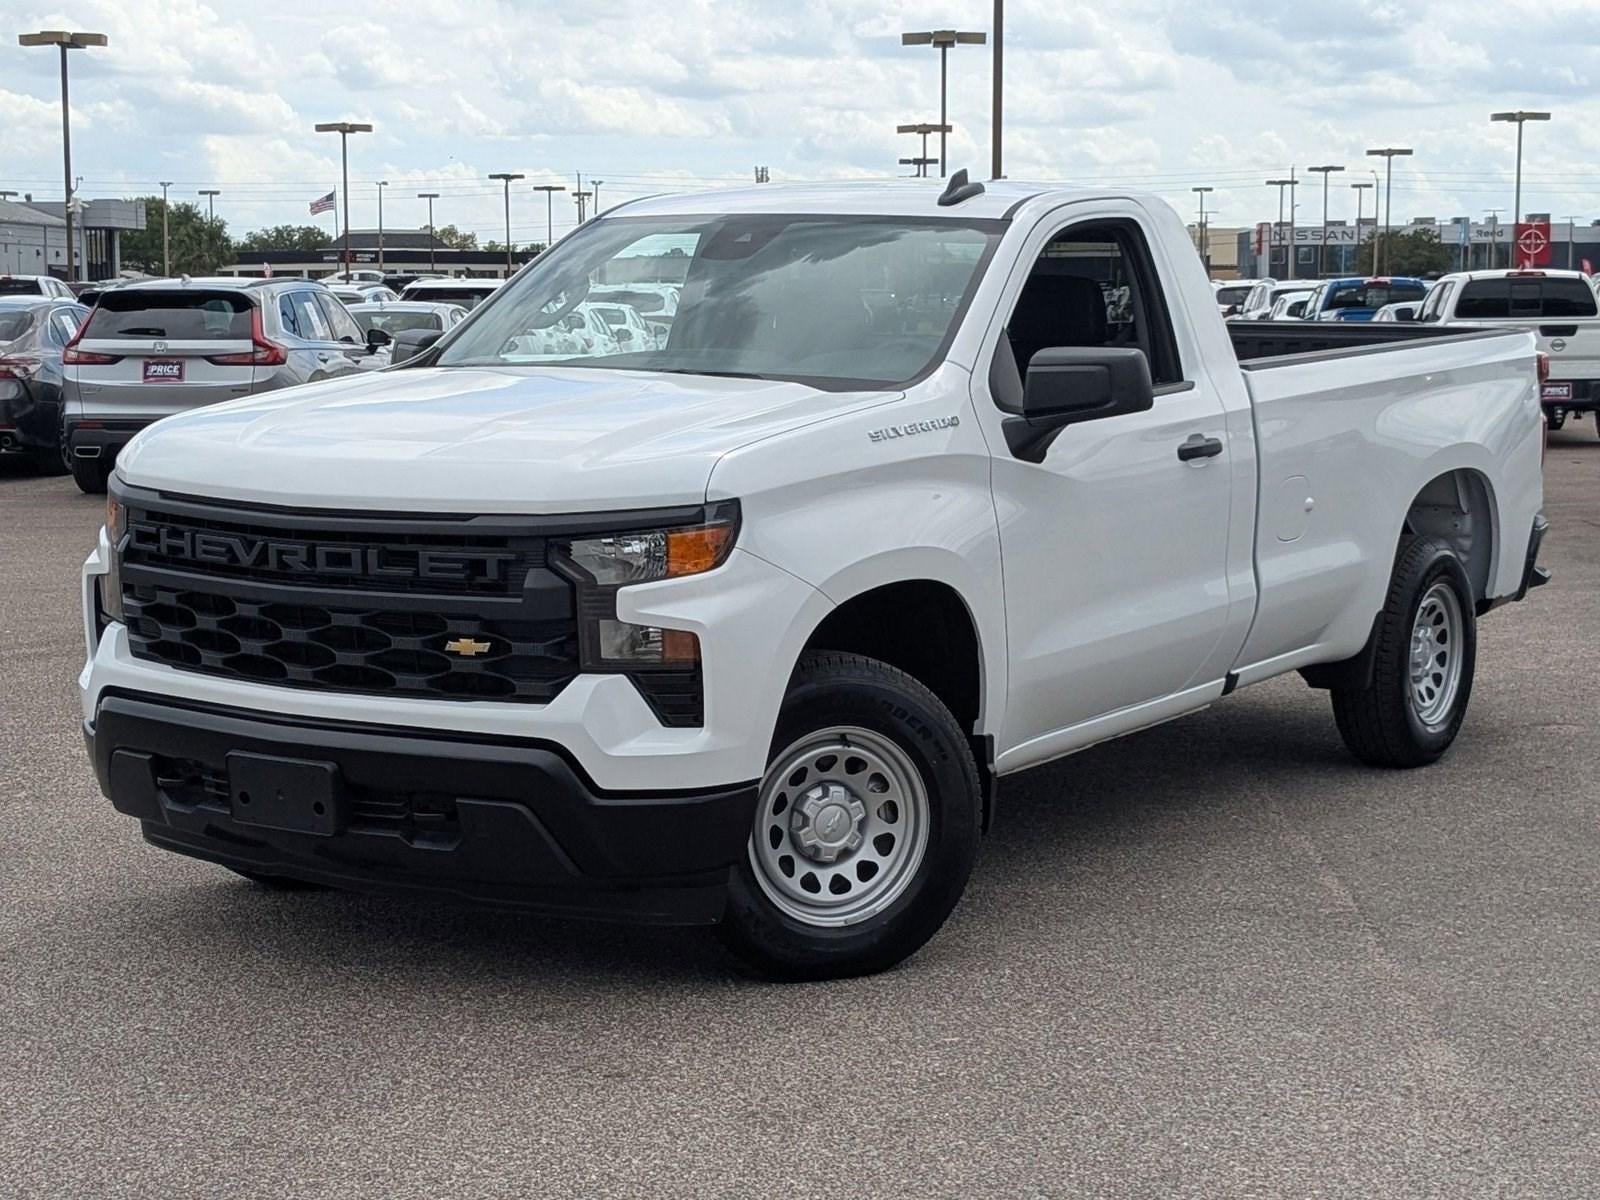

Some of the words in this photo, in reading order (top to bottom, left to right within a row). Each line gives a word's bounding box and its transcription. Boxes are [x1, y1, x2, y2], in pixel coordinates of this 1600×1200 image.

[149, 364, 180, 373] PRICE
[868, 415, 960, 442] SILVERADO
[129, 522, 517, 580] CHEVROLET
